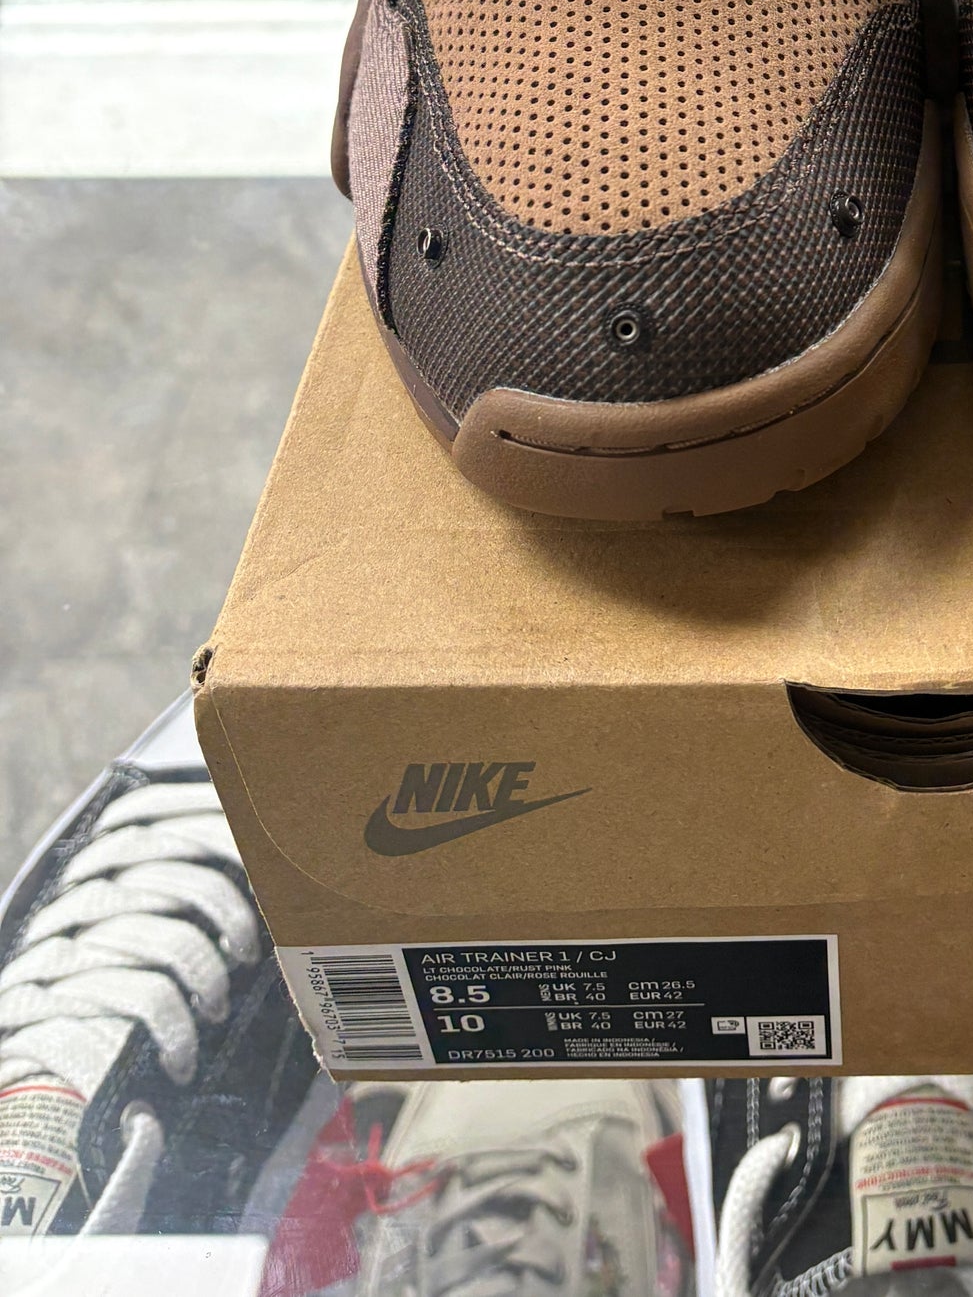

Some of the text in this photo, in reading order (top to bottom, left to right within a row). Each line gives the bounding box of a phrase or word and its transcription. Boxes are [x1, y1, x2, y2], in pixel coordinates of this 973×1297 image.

[392, 761, 536, 814] NIKE
[421, 953, 456, 964] AIR
[460, 951, 552, 963] TRAINER
[559, 951, 568, 962] 1
[589, 951, 617, 962] CJ
[439, 964, 542, 973] CHOCOLATE/RUST
[545, 964, 572, 972] PINK
[425, 971, 608, 982] CHOCOLAT CLAIR/ROSE ROUILLE
[553, 983, 606, 991] UK 7.5
[662, 980, 695, 989] 26.5
[429, 985, 490, 1004] 8.5
[555, 993, 577, 1001] BR
[629, 992, 661, 1000] EUR
[559, 1012, 611, 1020] UK 7.5
[666, 1011, 685, 1019] 27
[437, 1014, 485, 1033] 10
[561, 1021, 611, 1030] BR 40
[634, 1021, 687, 1029] EUR 42
[448, 1048, 554, 1060] DR7515 200
